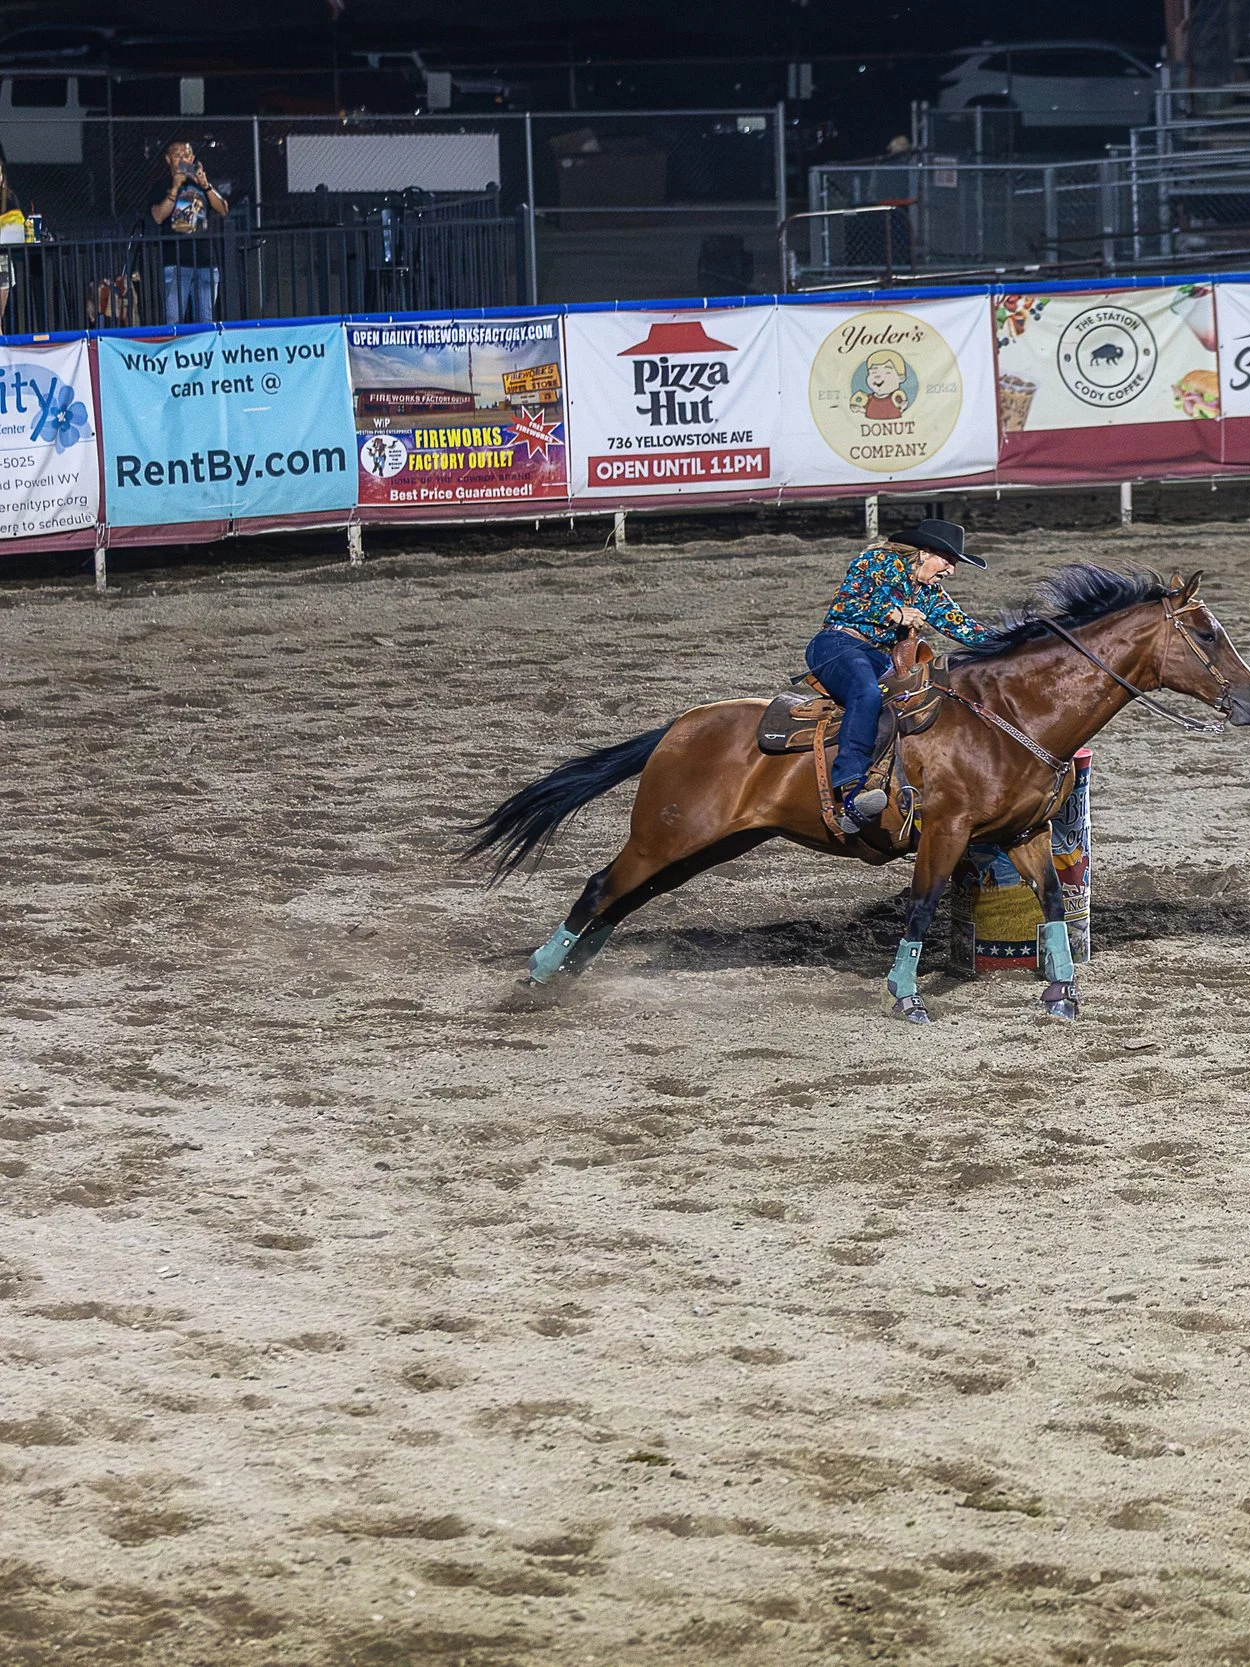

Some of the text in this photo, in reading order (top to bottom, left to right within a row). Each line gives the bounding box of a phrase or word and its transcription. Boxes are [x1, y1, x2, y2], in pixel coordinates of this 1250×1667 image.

[1075, 312, 1141, 332] THE STATION
[353, 325, 552, 346] OPEN DAILY! FIREWORKSFACTORY.COM
[838, 324, 925, 354] Yoder's
[122, 342, 326, 375] Why buy when you
[171, 372, 281, 398] can rent @
[632, 356, 730, 395] Pizza
[1074, 374, 1144, 401] CODY COFFEE
[636, 390, 714, 426] Hut
[414, 427, 502, 449] FIREWORKS
[861, 421, 915, 437] DONUT
[607, 430, 753, 450] 736 YELLOWSTONE AVE
[408, 452, 465, 471] FACTORY
[469, 450, 514, 469] OUTLET
[850, 442, 927, 460] COMPANY
[116, 446, 346, 487] RentBy.com
[596, 453, 763, 480] OPEN UNTIL 11PM
[15, 475, 54, 489] Powell
[57, 472, 80, 485] WY
[390, 483, 533, 501] Best Price Guaranteed!
[22, 521, 35, 531] to
[39, 513, 92, 530] schedule
